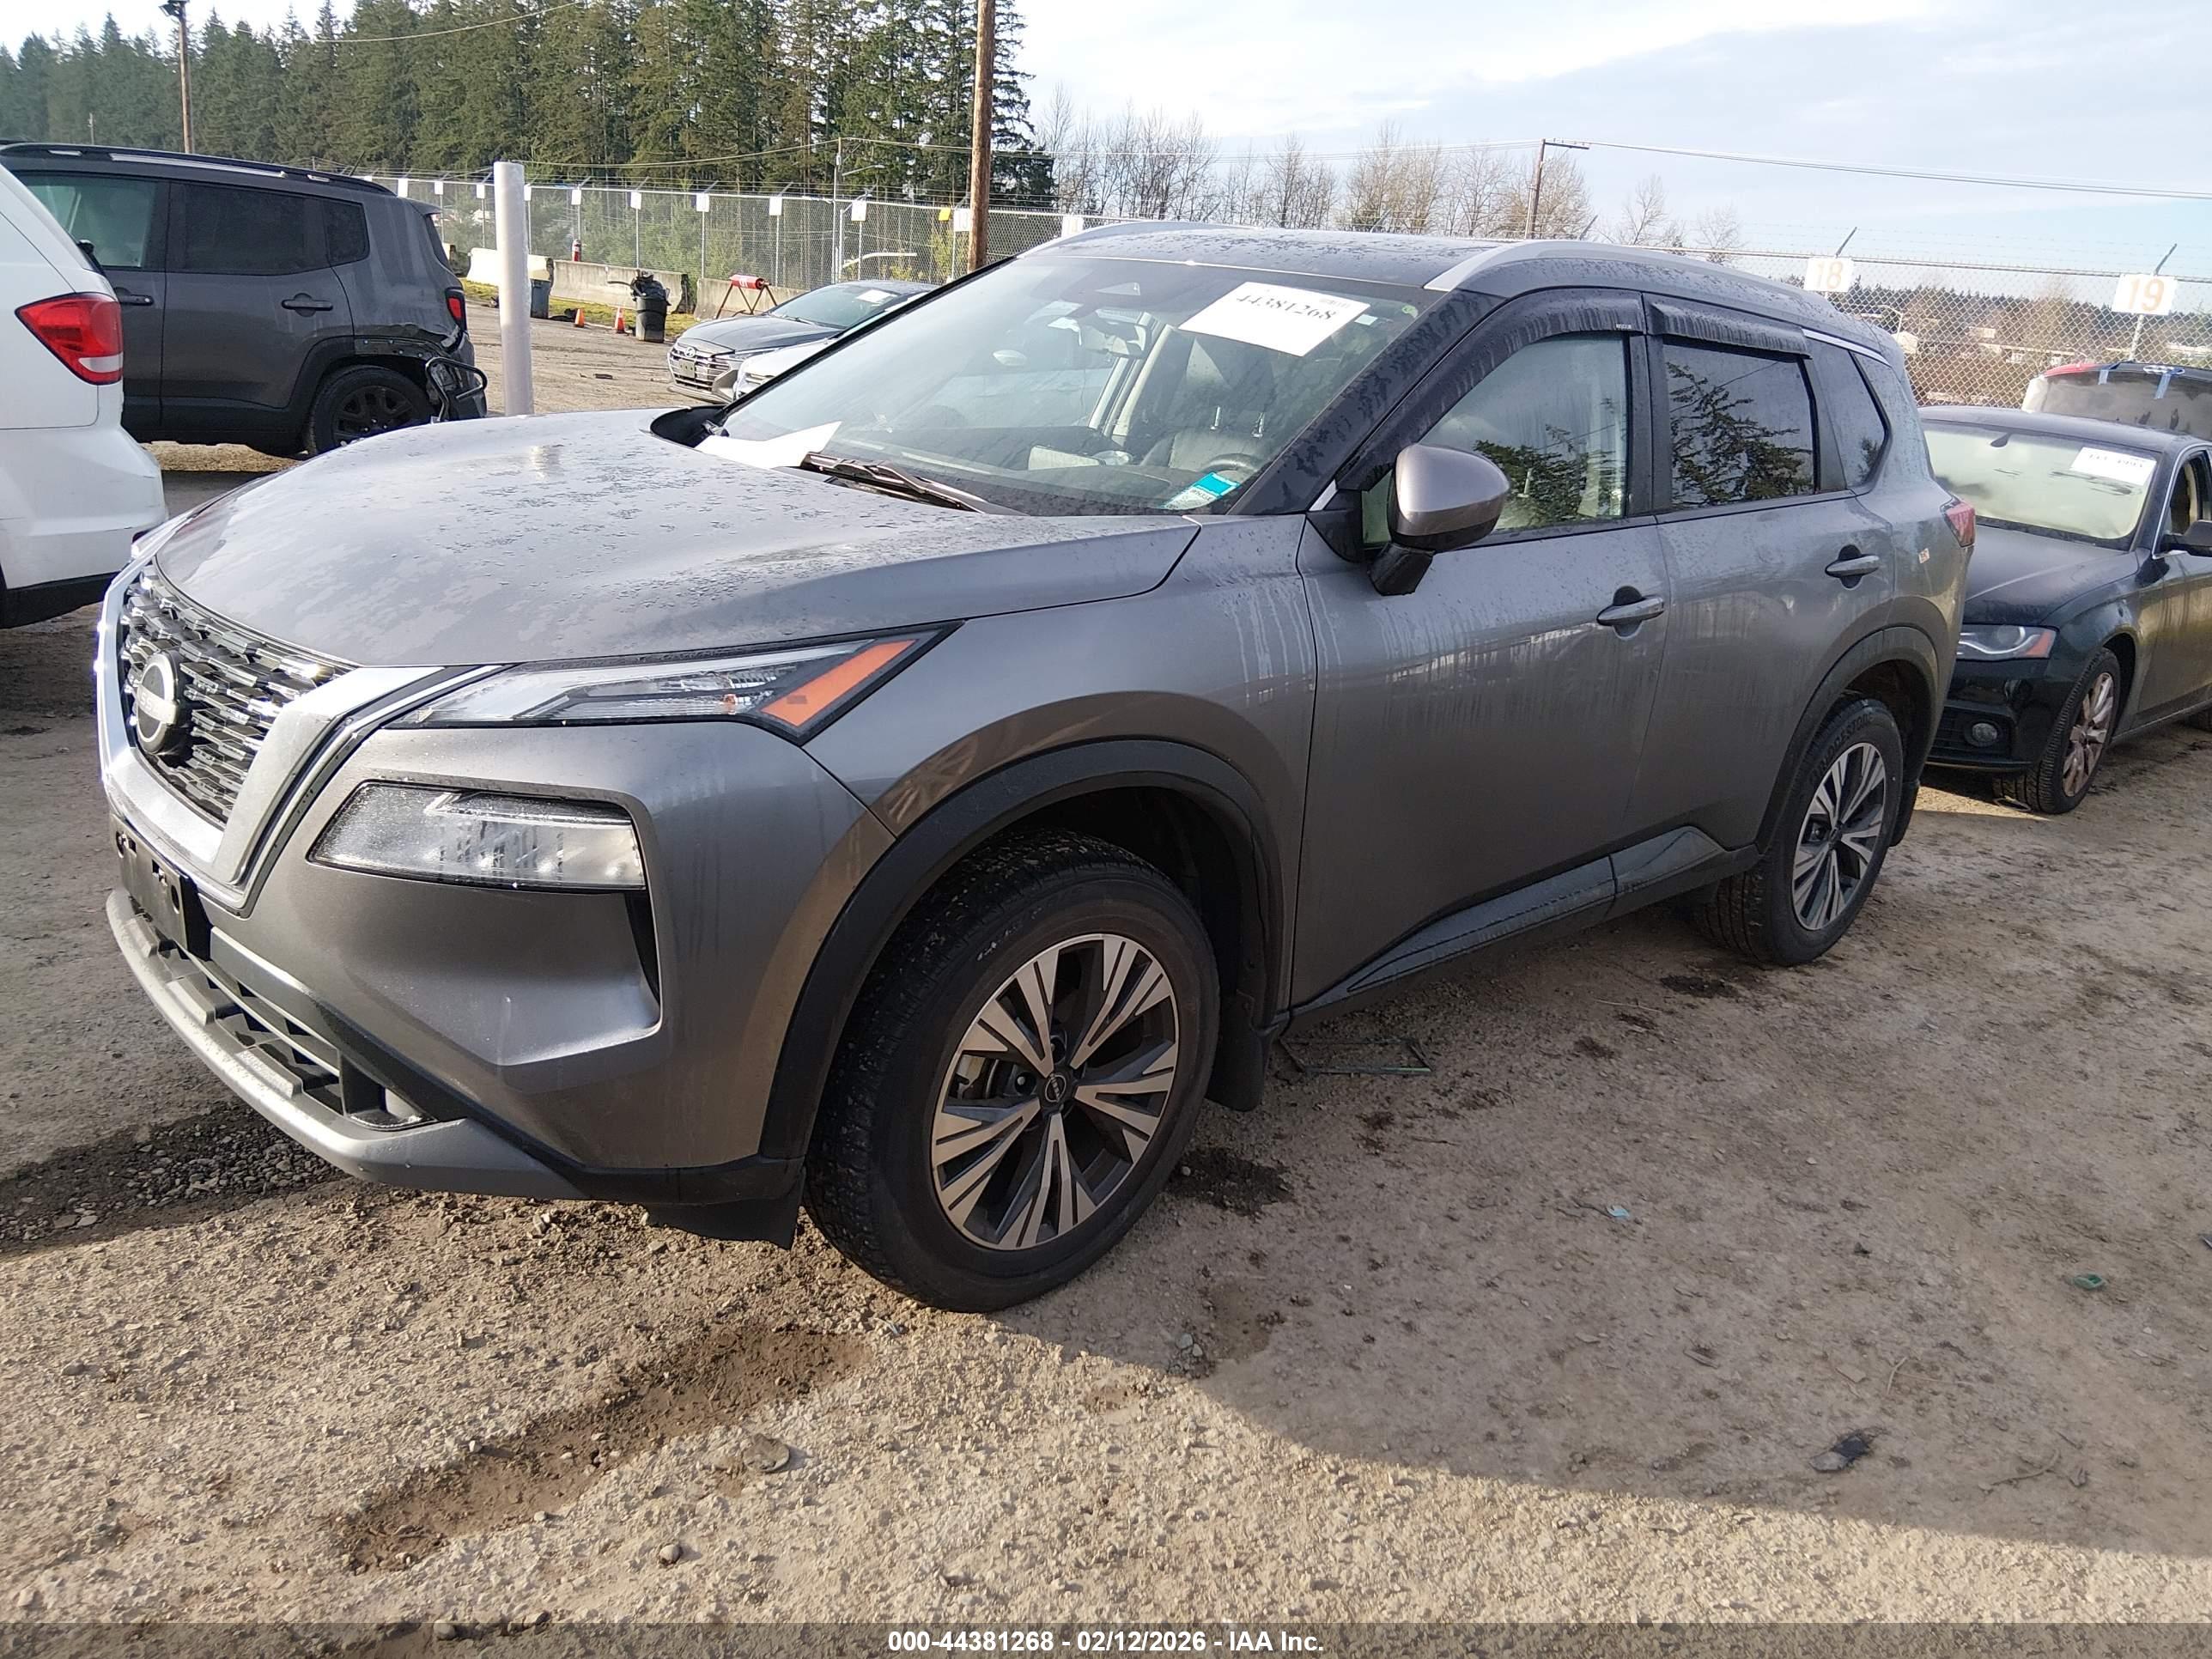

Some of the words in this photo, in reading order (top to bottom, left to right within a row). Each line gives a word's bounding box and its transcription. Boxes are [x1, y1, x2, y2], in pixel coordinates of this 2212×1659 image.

[1816, 260, 1843, 290] 18
[1236, 295, 1337, 320] 44381268
[2129, 277, 2165, 312] 19
